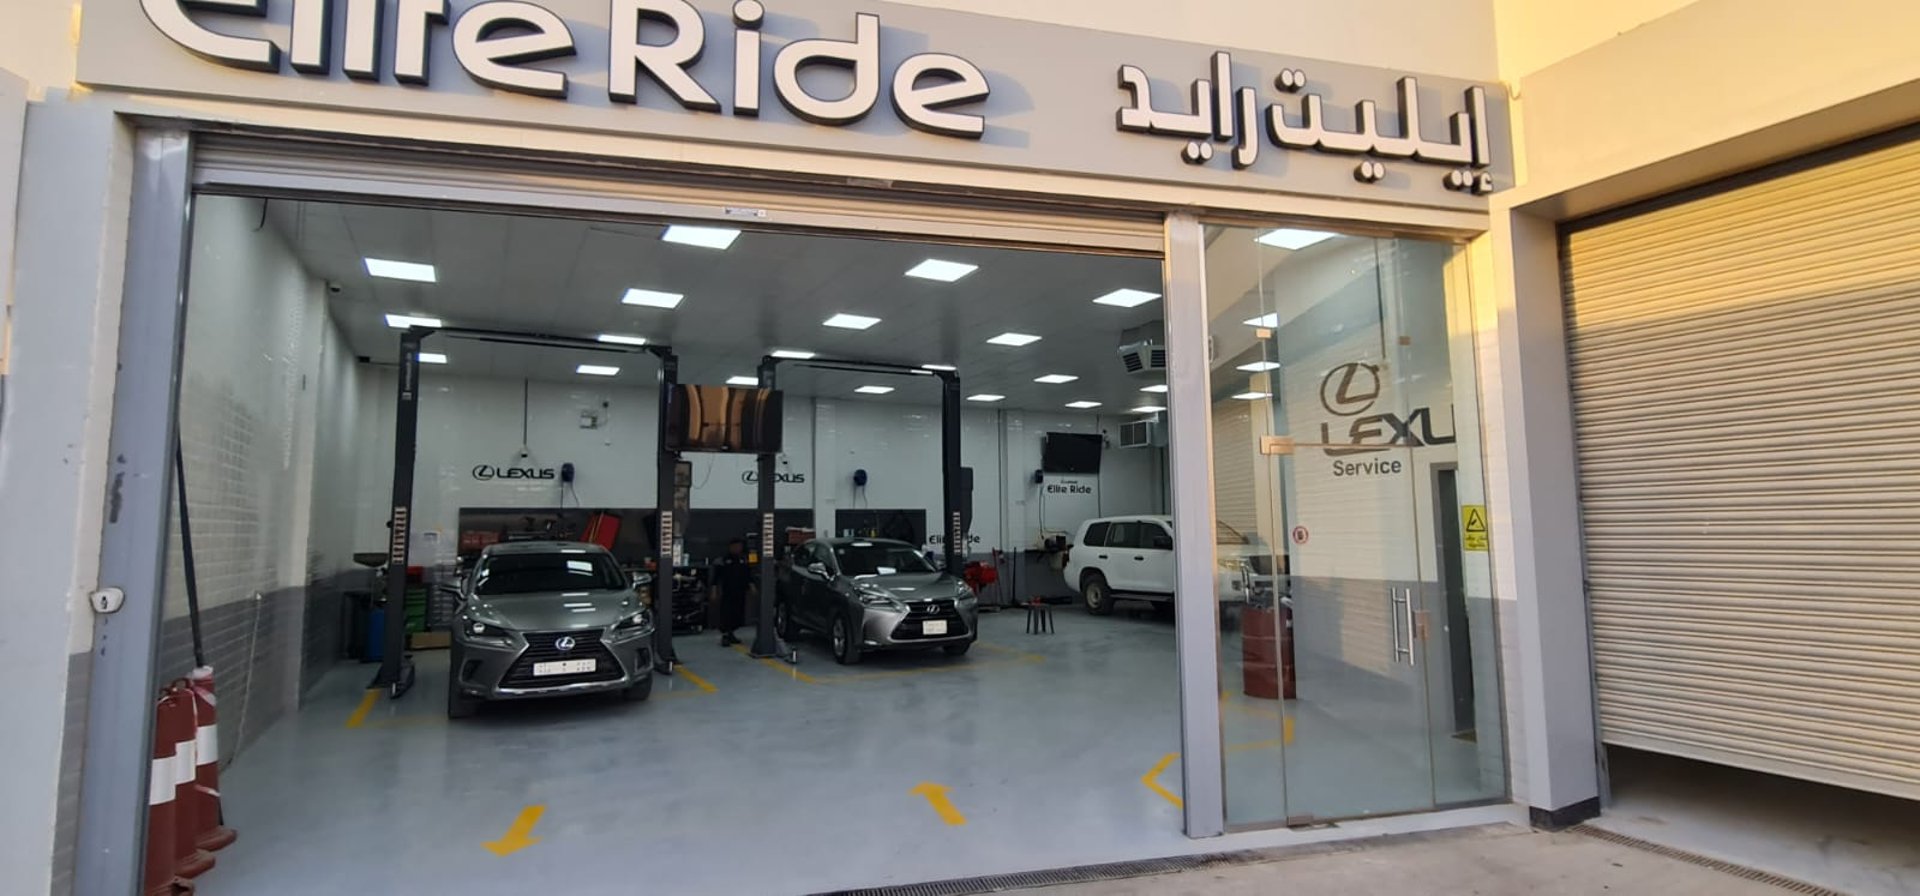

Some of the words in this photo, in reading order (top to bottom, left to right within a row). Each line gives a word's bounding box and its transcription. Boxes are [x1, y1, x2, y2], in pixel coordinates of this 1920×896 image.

[608, 0, 991, 140] Ride
[1116, 50, 1260, 170] رايد
[1320, 404, 1457, 457] LEXU
[496, 467, 555, 479] LEXUS
[1332, 458, 1402, 477] Service
